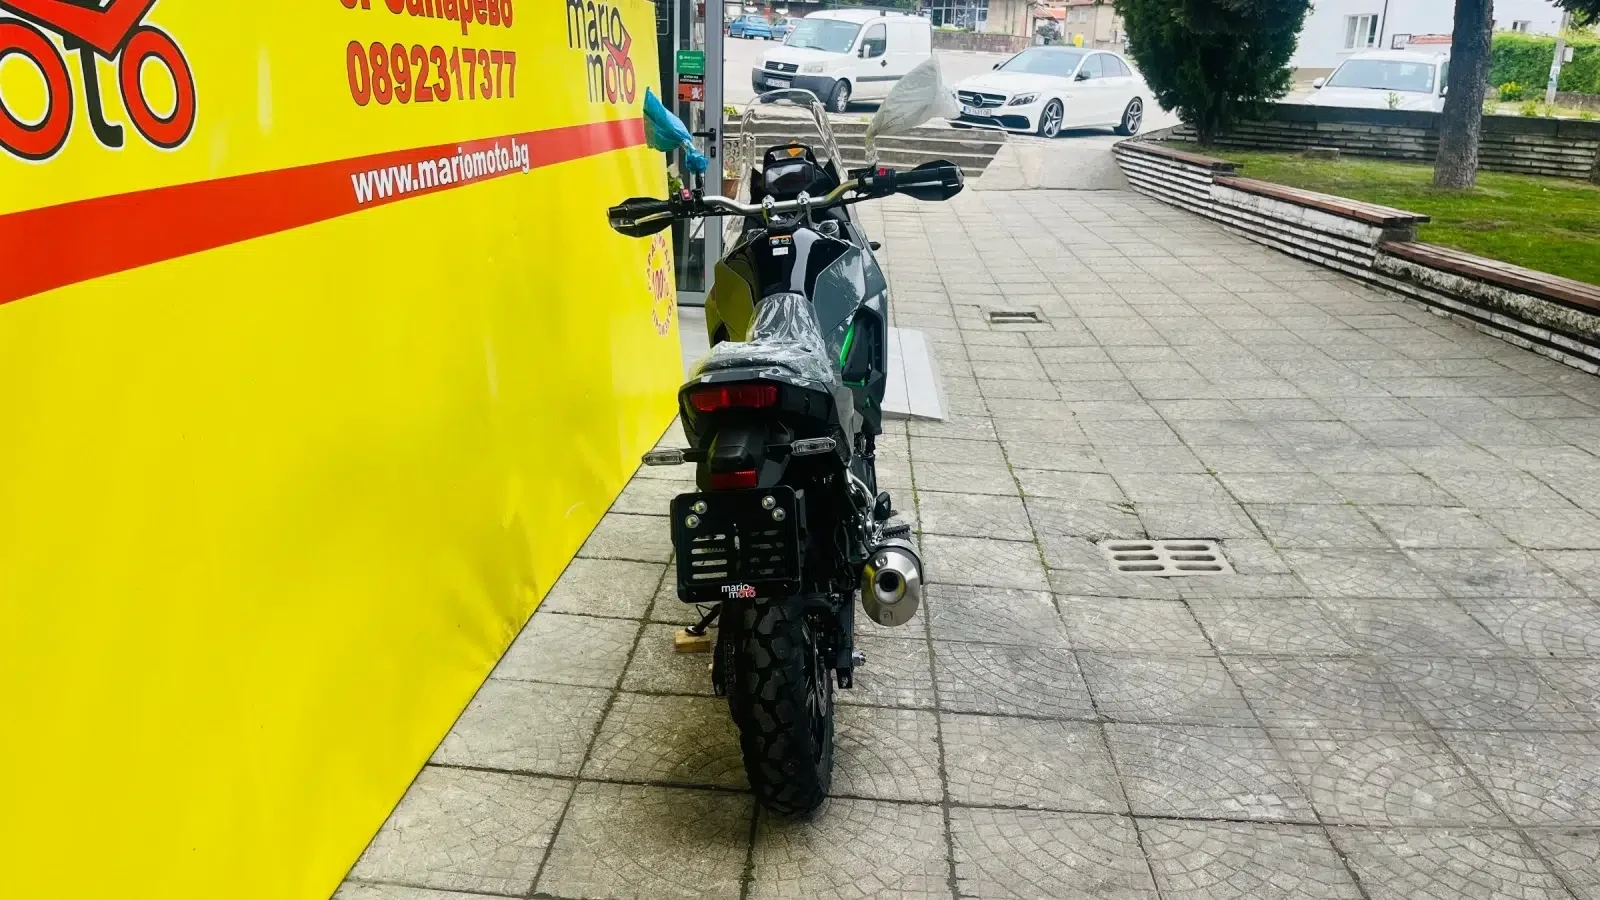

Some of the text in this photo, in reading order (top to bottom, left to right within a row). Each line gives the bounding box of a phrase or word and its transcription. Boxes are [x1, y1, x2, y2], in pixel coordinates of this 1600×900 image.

[383, 0, 513, 36] апарево
[566, 0, 624, 52] mario
[346, 39, 517, 106] 0892317377
[586, 52, 636, 104] moto
[350, 137, 530, 204] www.mariomoto.bg
[721, 582, 750, 592] mario
[728, 590, 756, 598] moto
